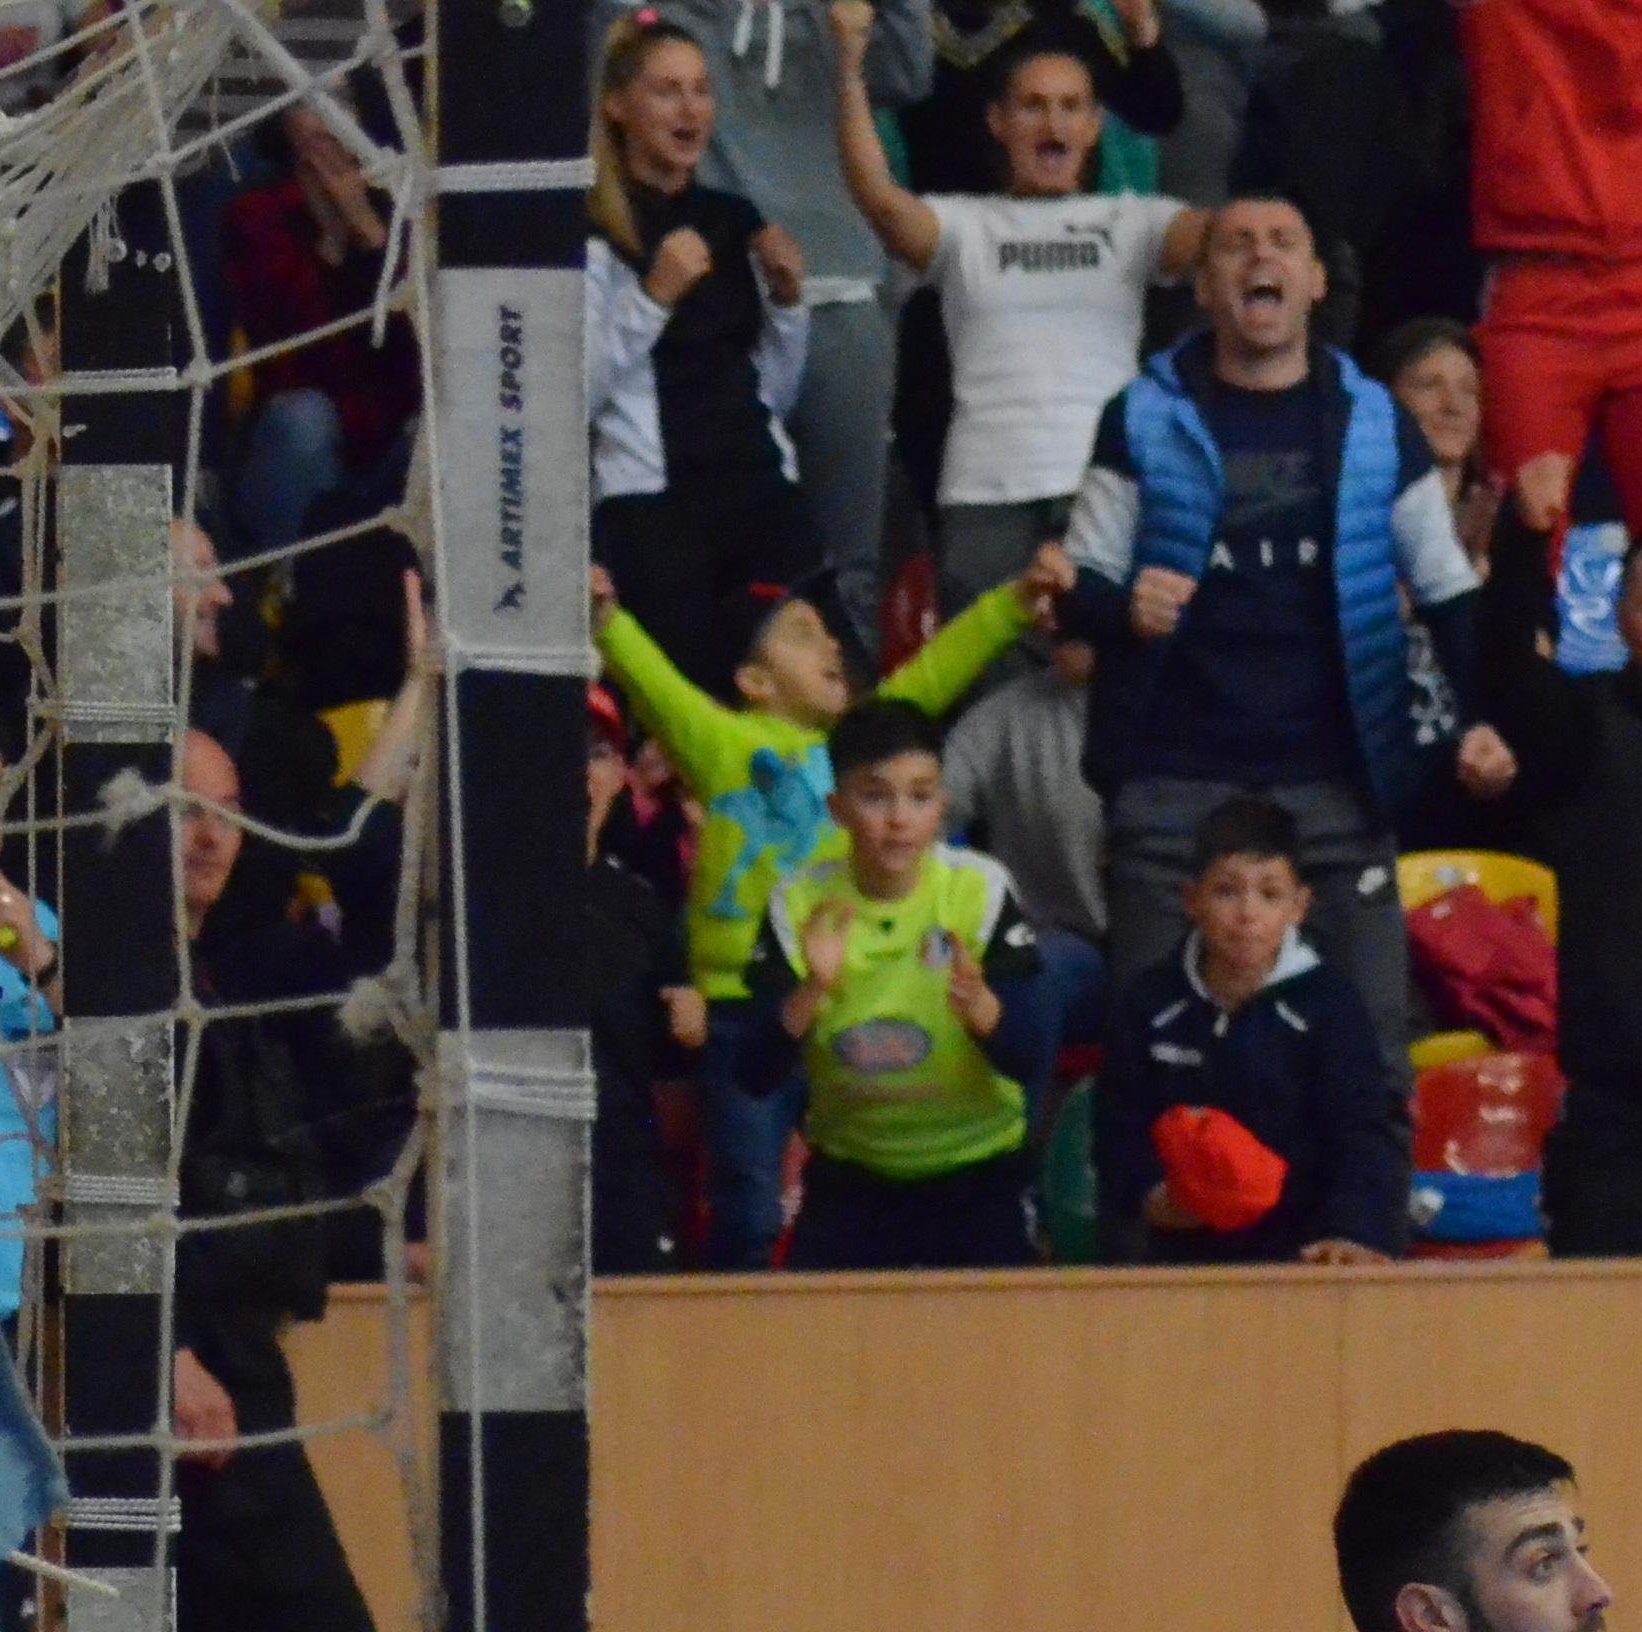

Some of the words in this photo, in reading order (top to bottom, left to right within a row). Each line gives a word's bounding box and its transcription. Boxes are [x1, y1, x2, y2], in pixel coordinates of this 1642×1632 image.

[998, 241, 1100, 274] PUMA
[498, 303, 524, 413] SPORT
[499, 423, 524, 571] ARTIMEX
[1209, 537, 1319, 573] AIR
